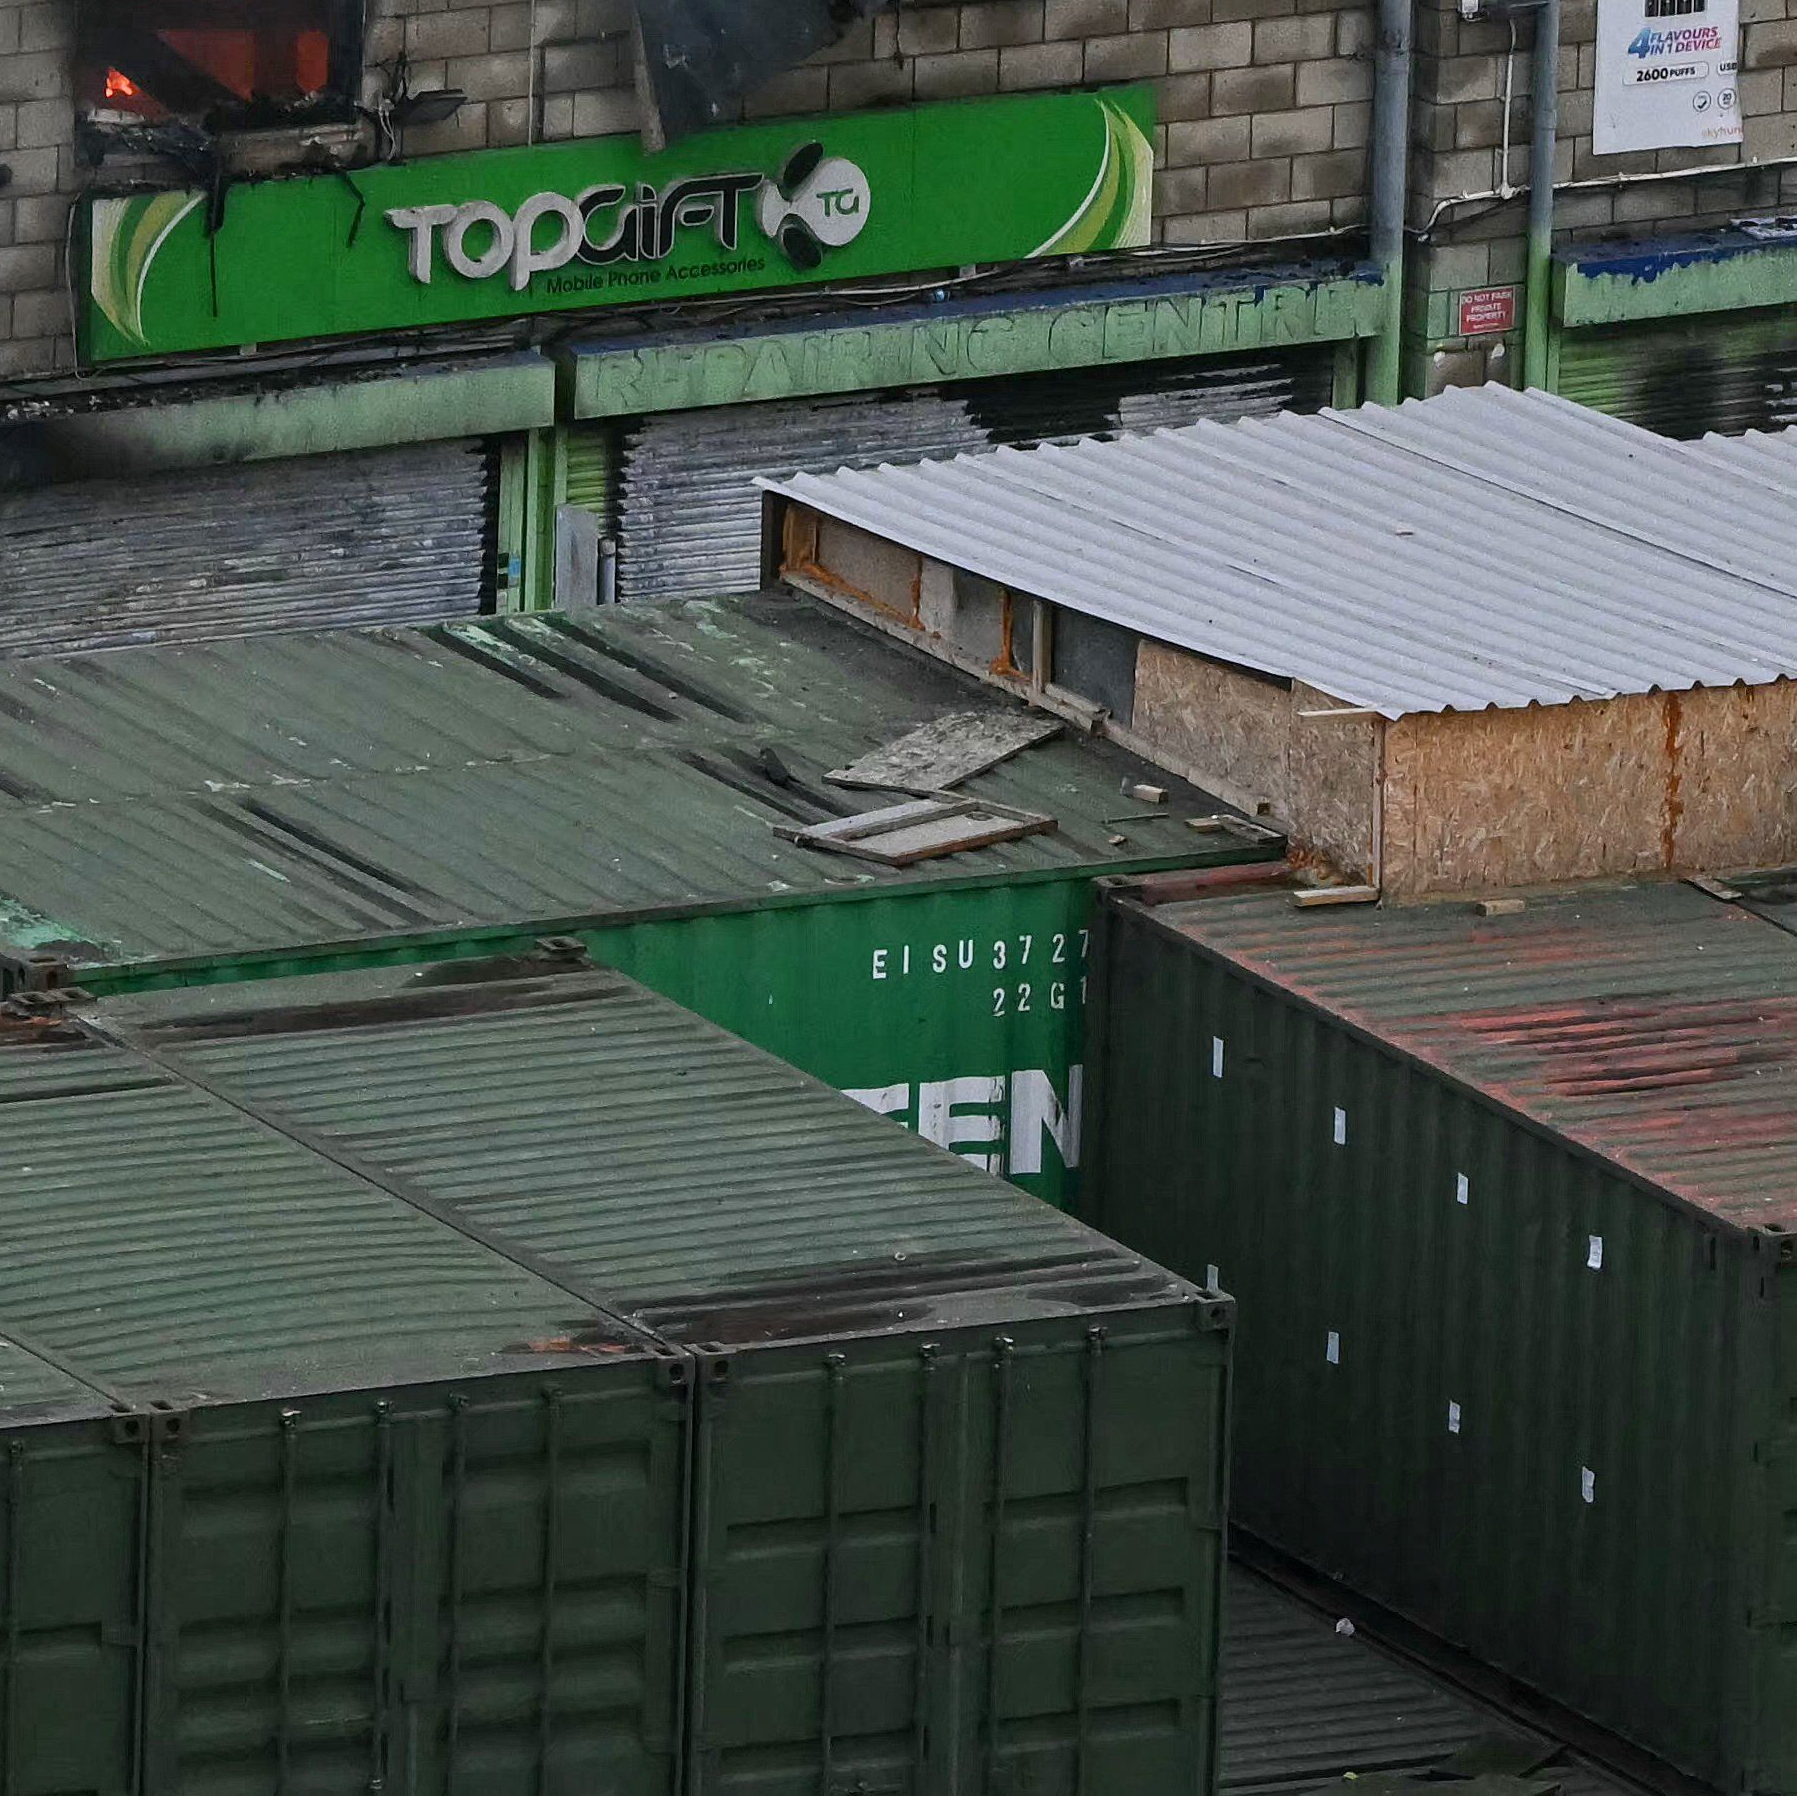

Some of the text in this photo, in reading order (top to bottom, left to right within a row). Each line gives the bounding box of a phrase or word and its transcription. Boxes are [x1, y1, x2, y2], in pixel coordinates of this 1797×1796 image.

[1628, 26, 1719, 59] 4 FLAVOURS
[1650, 44, 1665, 55] IN
[1675, 37, 1722, 53] DEVICE
[1636, 67, 1669, 82] 2600
[1669, 66, 1696, 78] PUFFS
[547, 257, 766, 294] Mobile Phone Accessories
